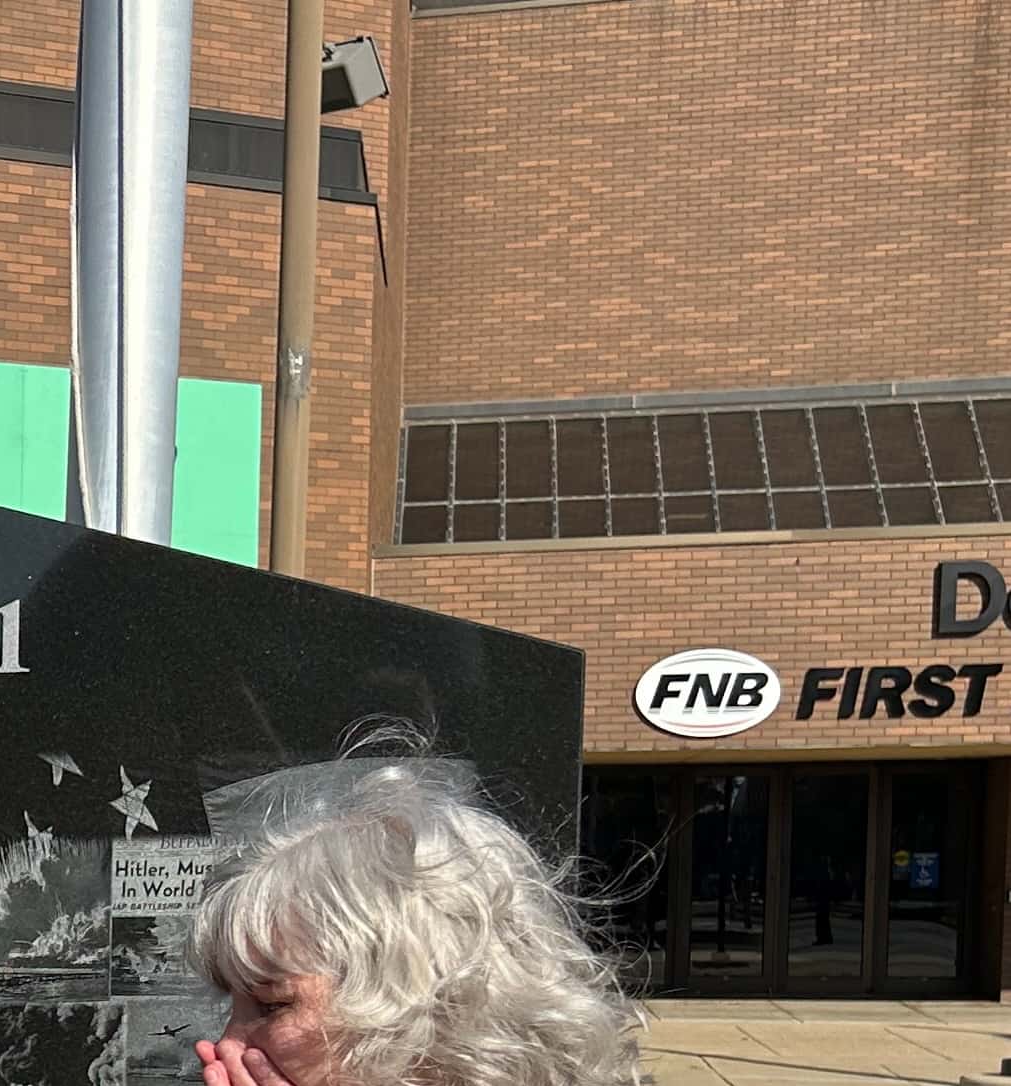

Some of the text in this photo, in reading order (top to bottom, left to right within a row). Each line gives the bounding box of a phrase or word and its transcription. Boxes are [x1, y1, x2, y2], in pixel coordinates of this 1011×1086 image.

[648, 664, 1003, 721] FNB FIRST
[115, 860, 169, 878] Hitler,
[122, 880, 196, 898] In World
